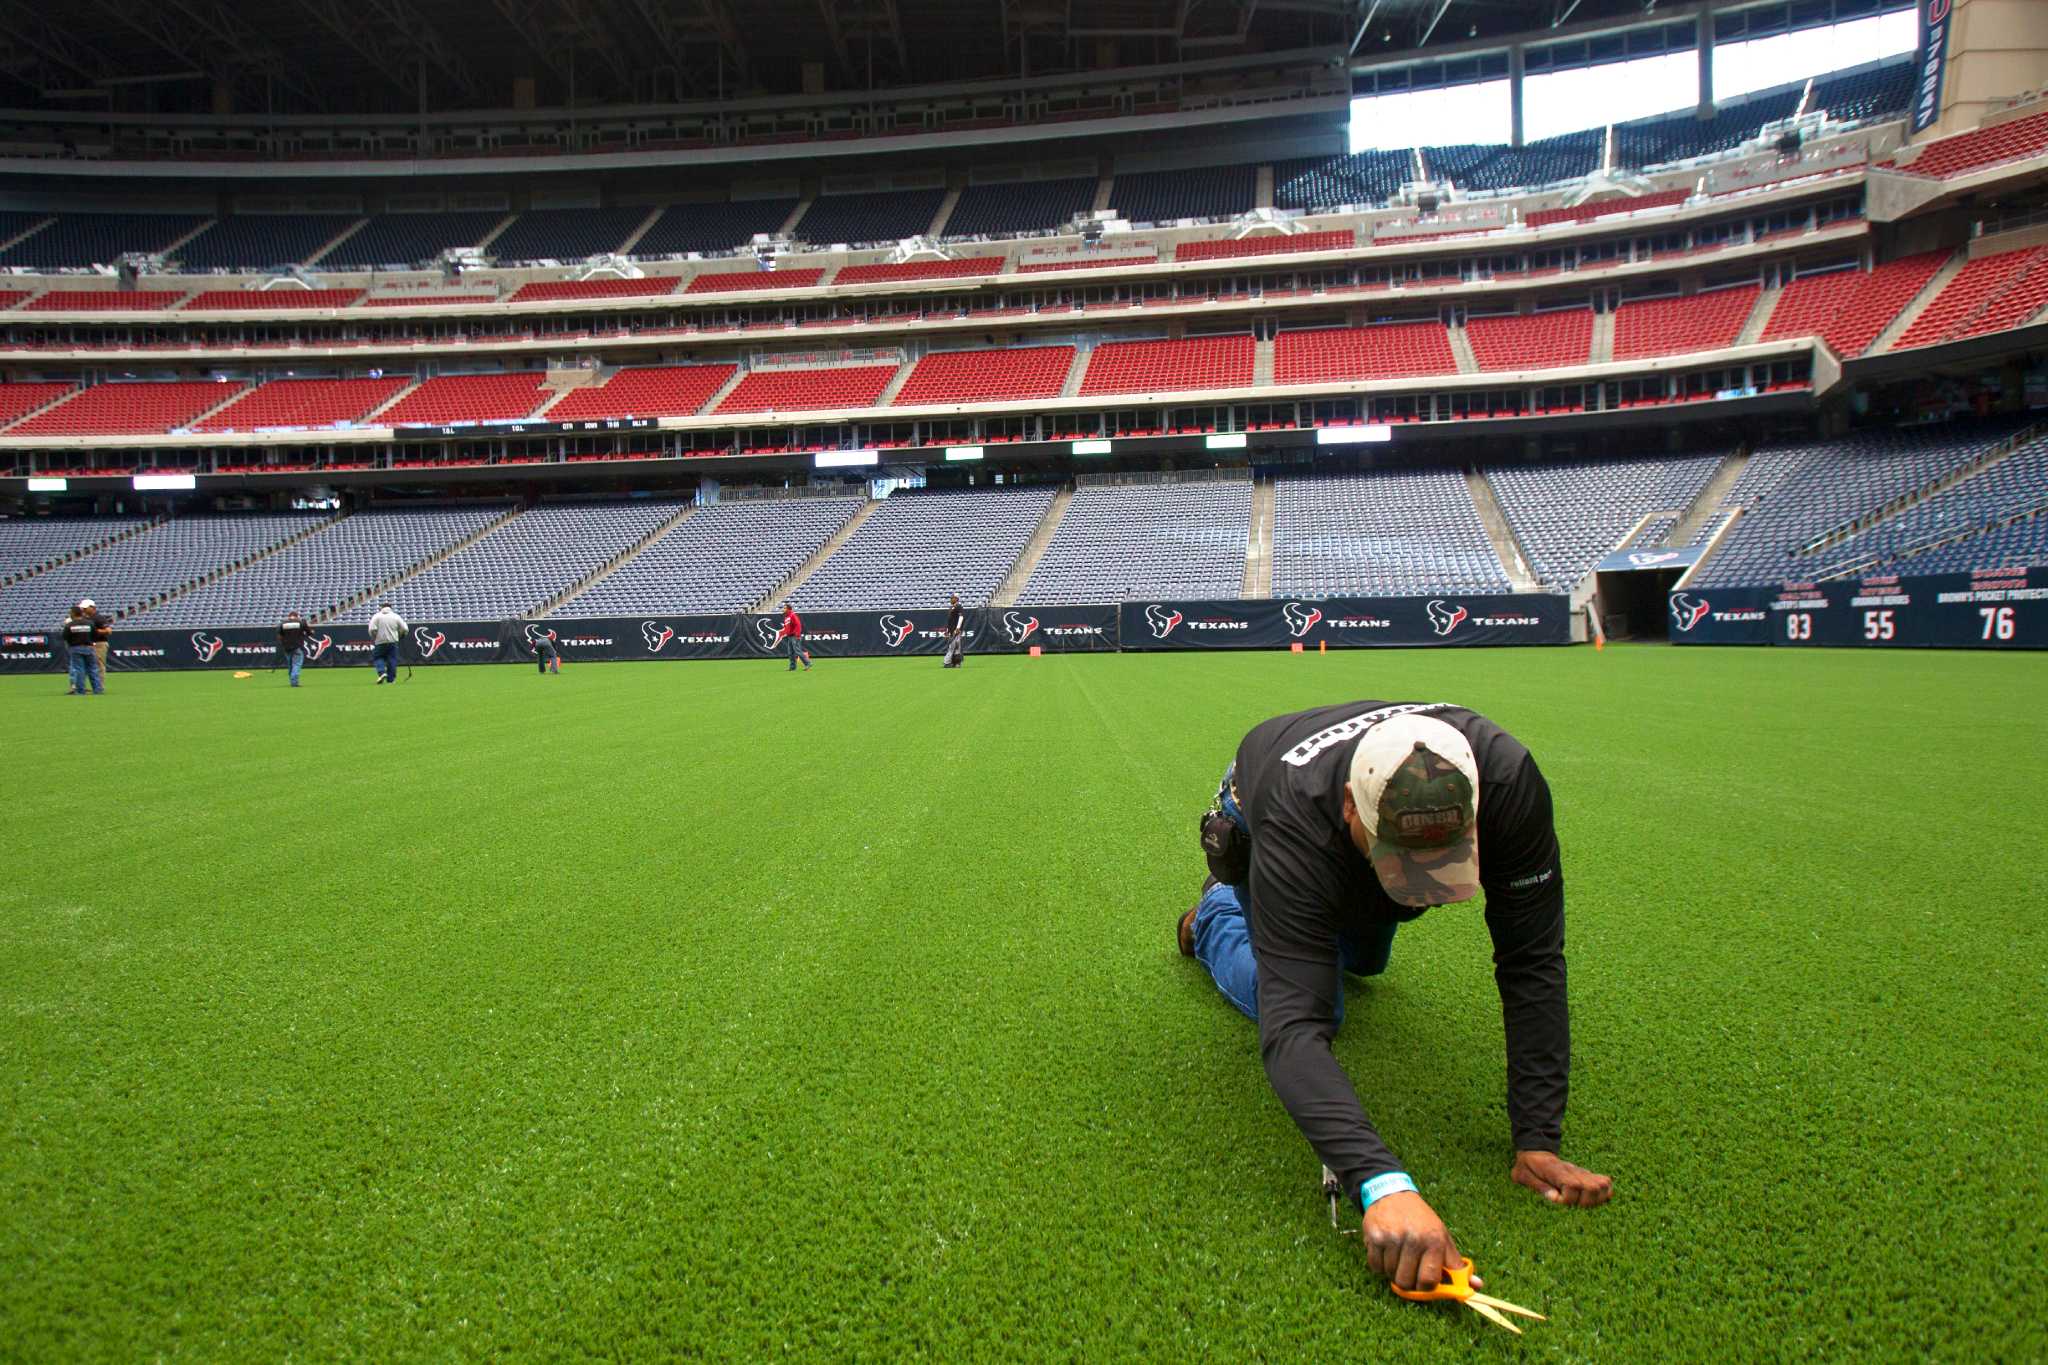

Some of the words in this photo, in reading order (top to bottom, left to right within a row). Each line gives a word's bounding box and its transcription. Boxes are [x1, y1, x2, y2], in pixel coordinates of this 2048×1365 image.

[1712, 611, 1767, 621] TEXANS
[1187, 621, 1248, 630] TEXANS
[1326, 619, 1391, 628] TEXANS
[1472, 617, 1540, 626] TEXANS
[1864, 610, 1895, 640] 55
[1979, 607, 2015, 640] 76
[1044, 627, 1103, 635] TEXANS
[1787, 613, 1811, 640] 83
[560, 638, 613, 646] TEXANS
[678, 635, 730, 643] TEXANS
